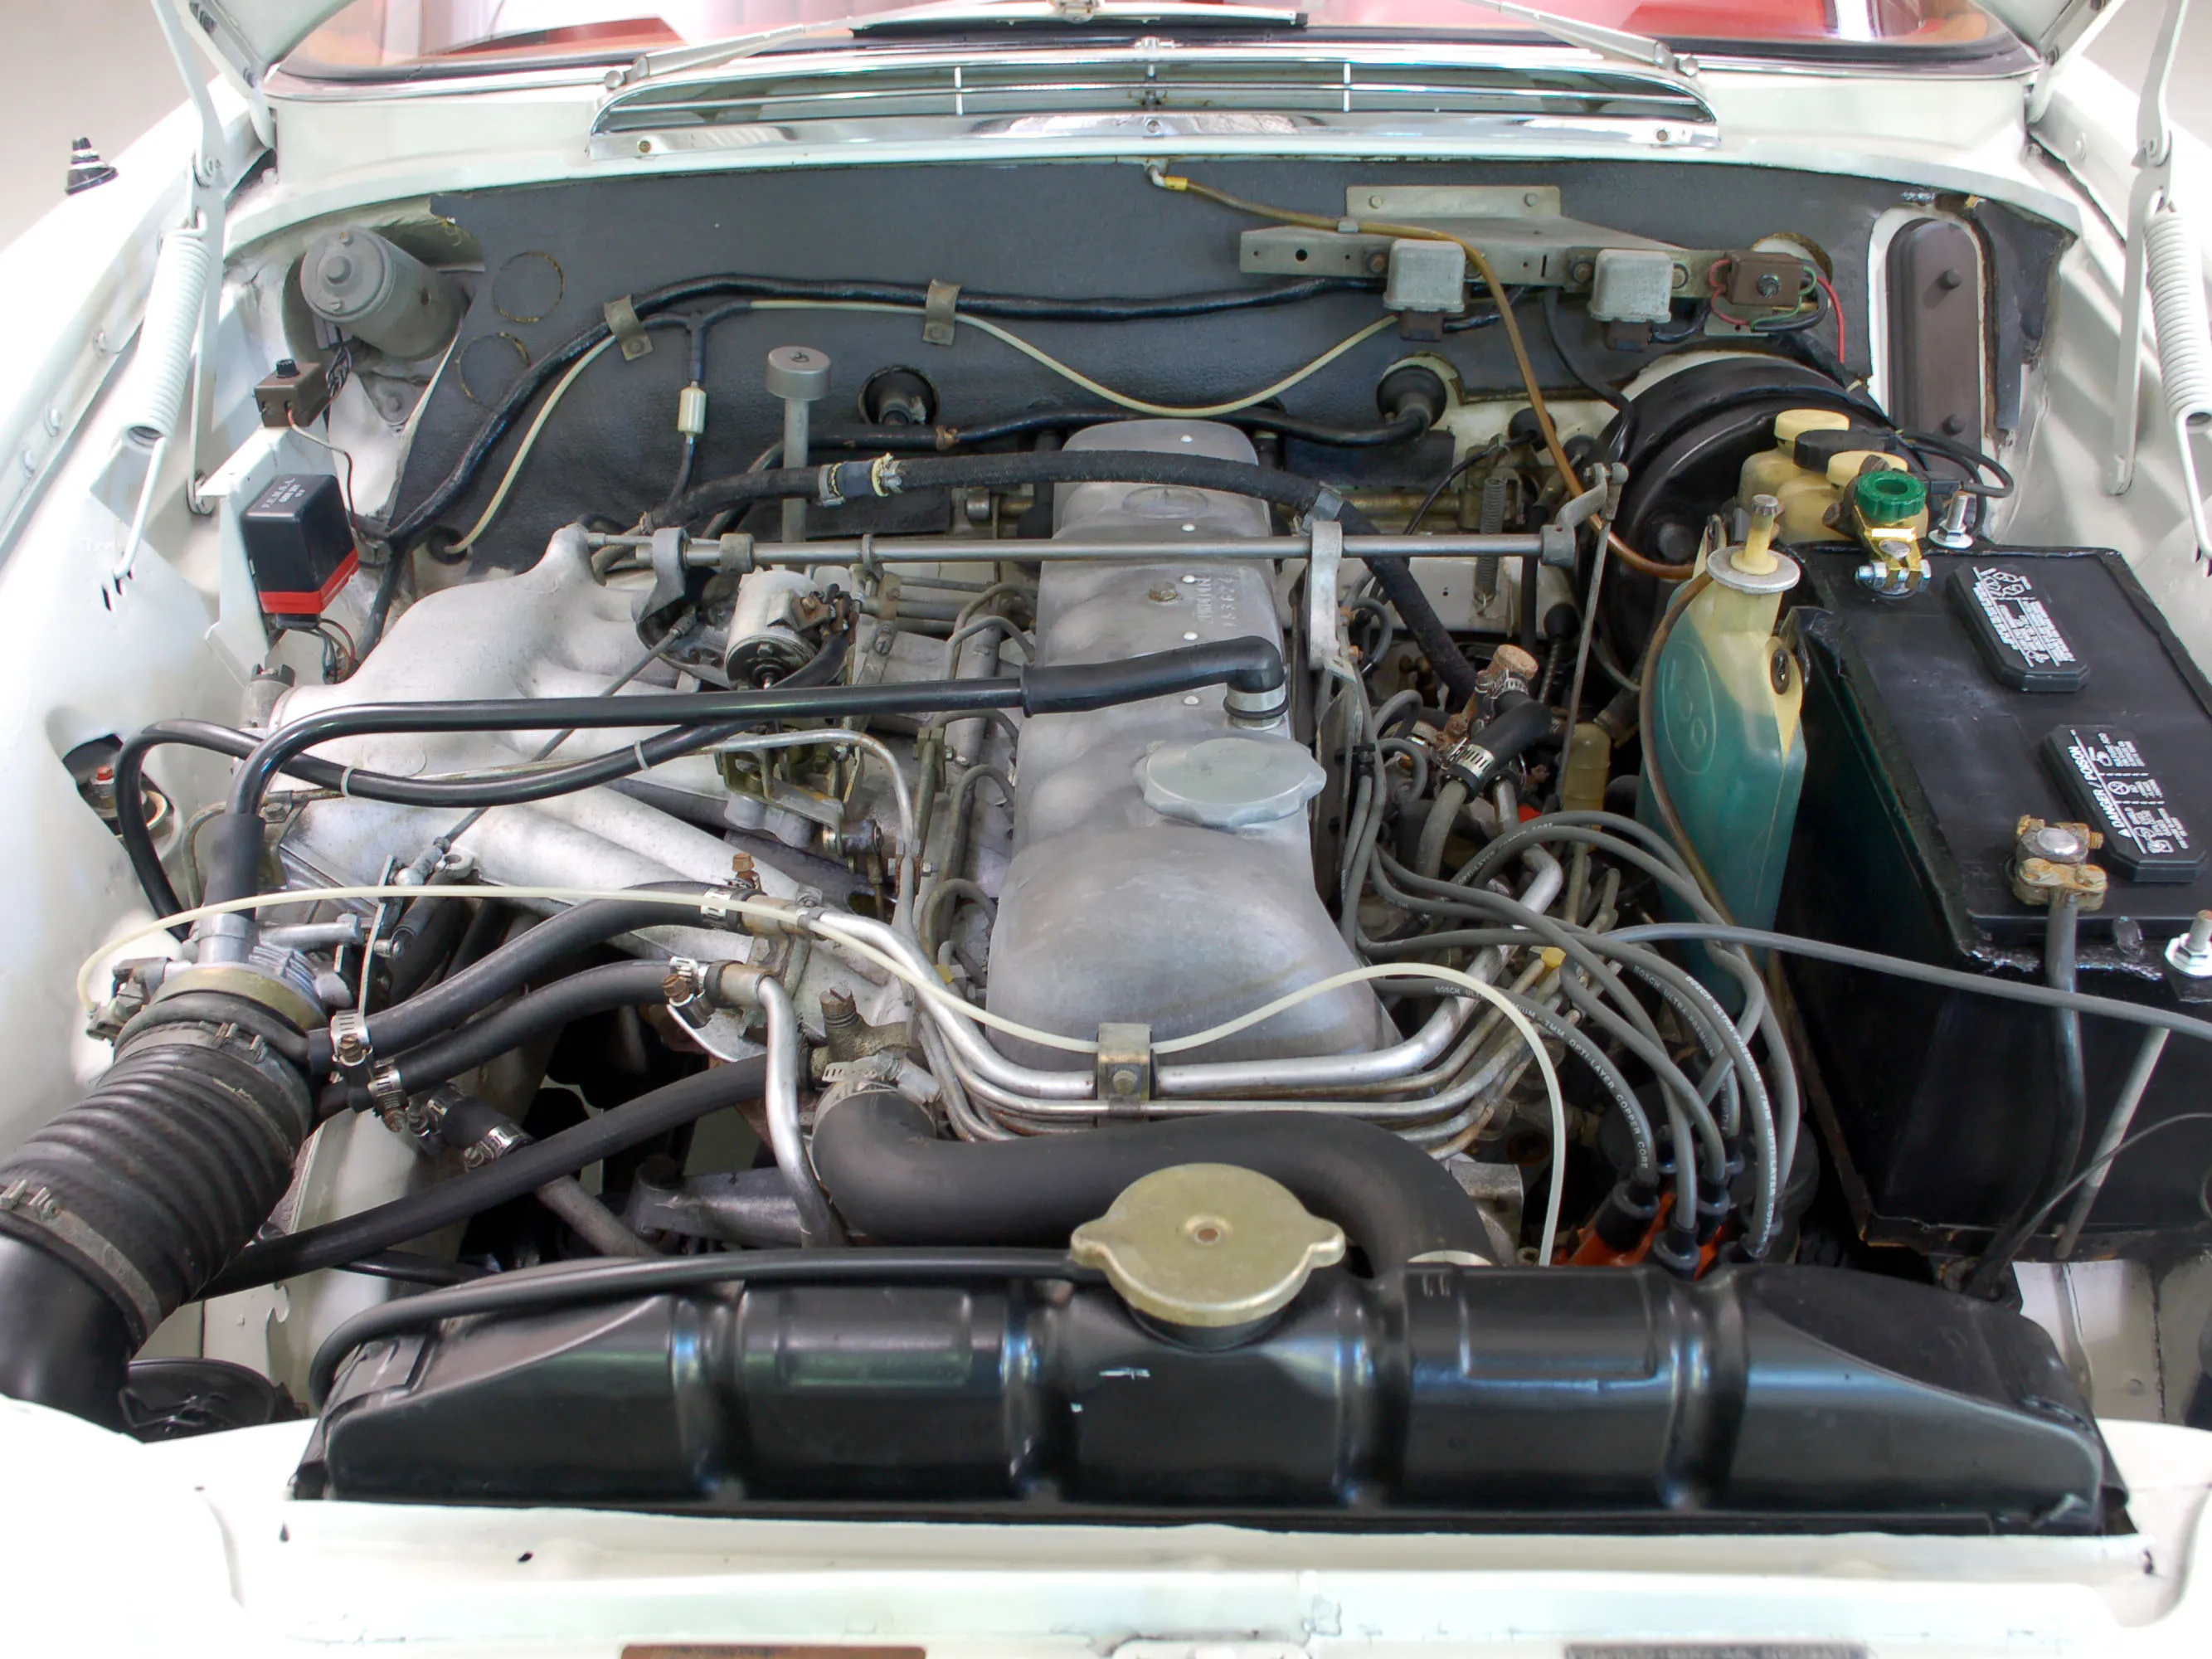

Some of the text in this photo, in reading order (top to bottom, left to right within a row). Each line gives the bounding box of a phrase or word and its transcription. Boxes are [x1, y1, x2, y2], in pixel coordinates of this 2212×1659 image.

[2067, 746, 2098, 780] POISON
[2092, 789, 2126, 828] DANGER
[1685, 975, 1713, 1000] BOSCH
[1633, 965, 1716, 1058] BOSCH ULTRA-PREMIUM
[1544, 1019, 1566, 1037] 7MM
[1568, 1039, 1616, 1090] OPTI-LAYER
[1616, 1094, 1641, 1135] COPPER
[1637, 1141, 1649, 1169] CORE
